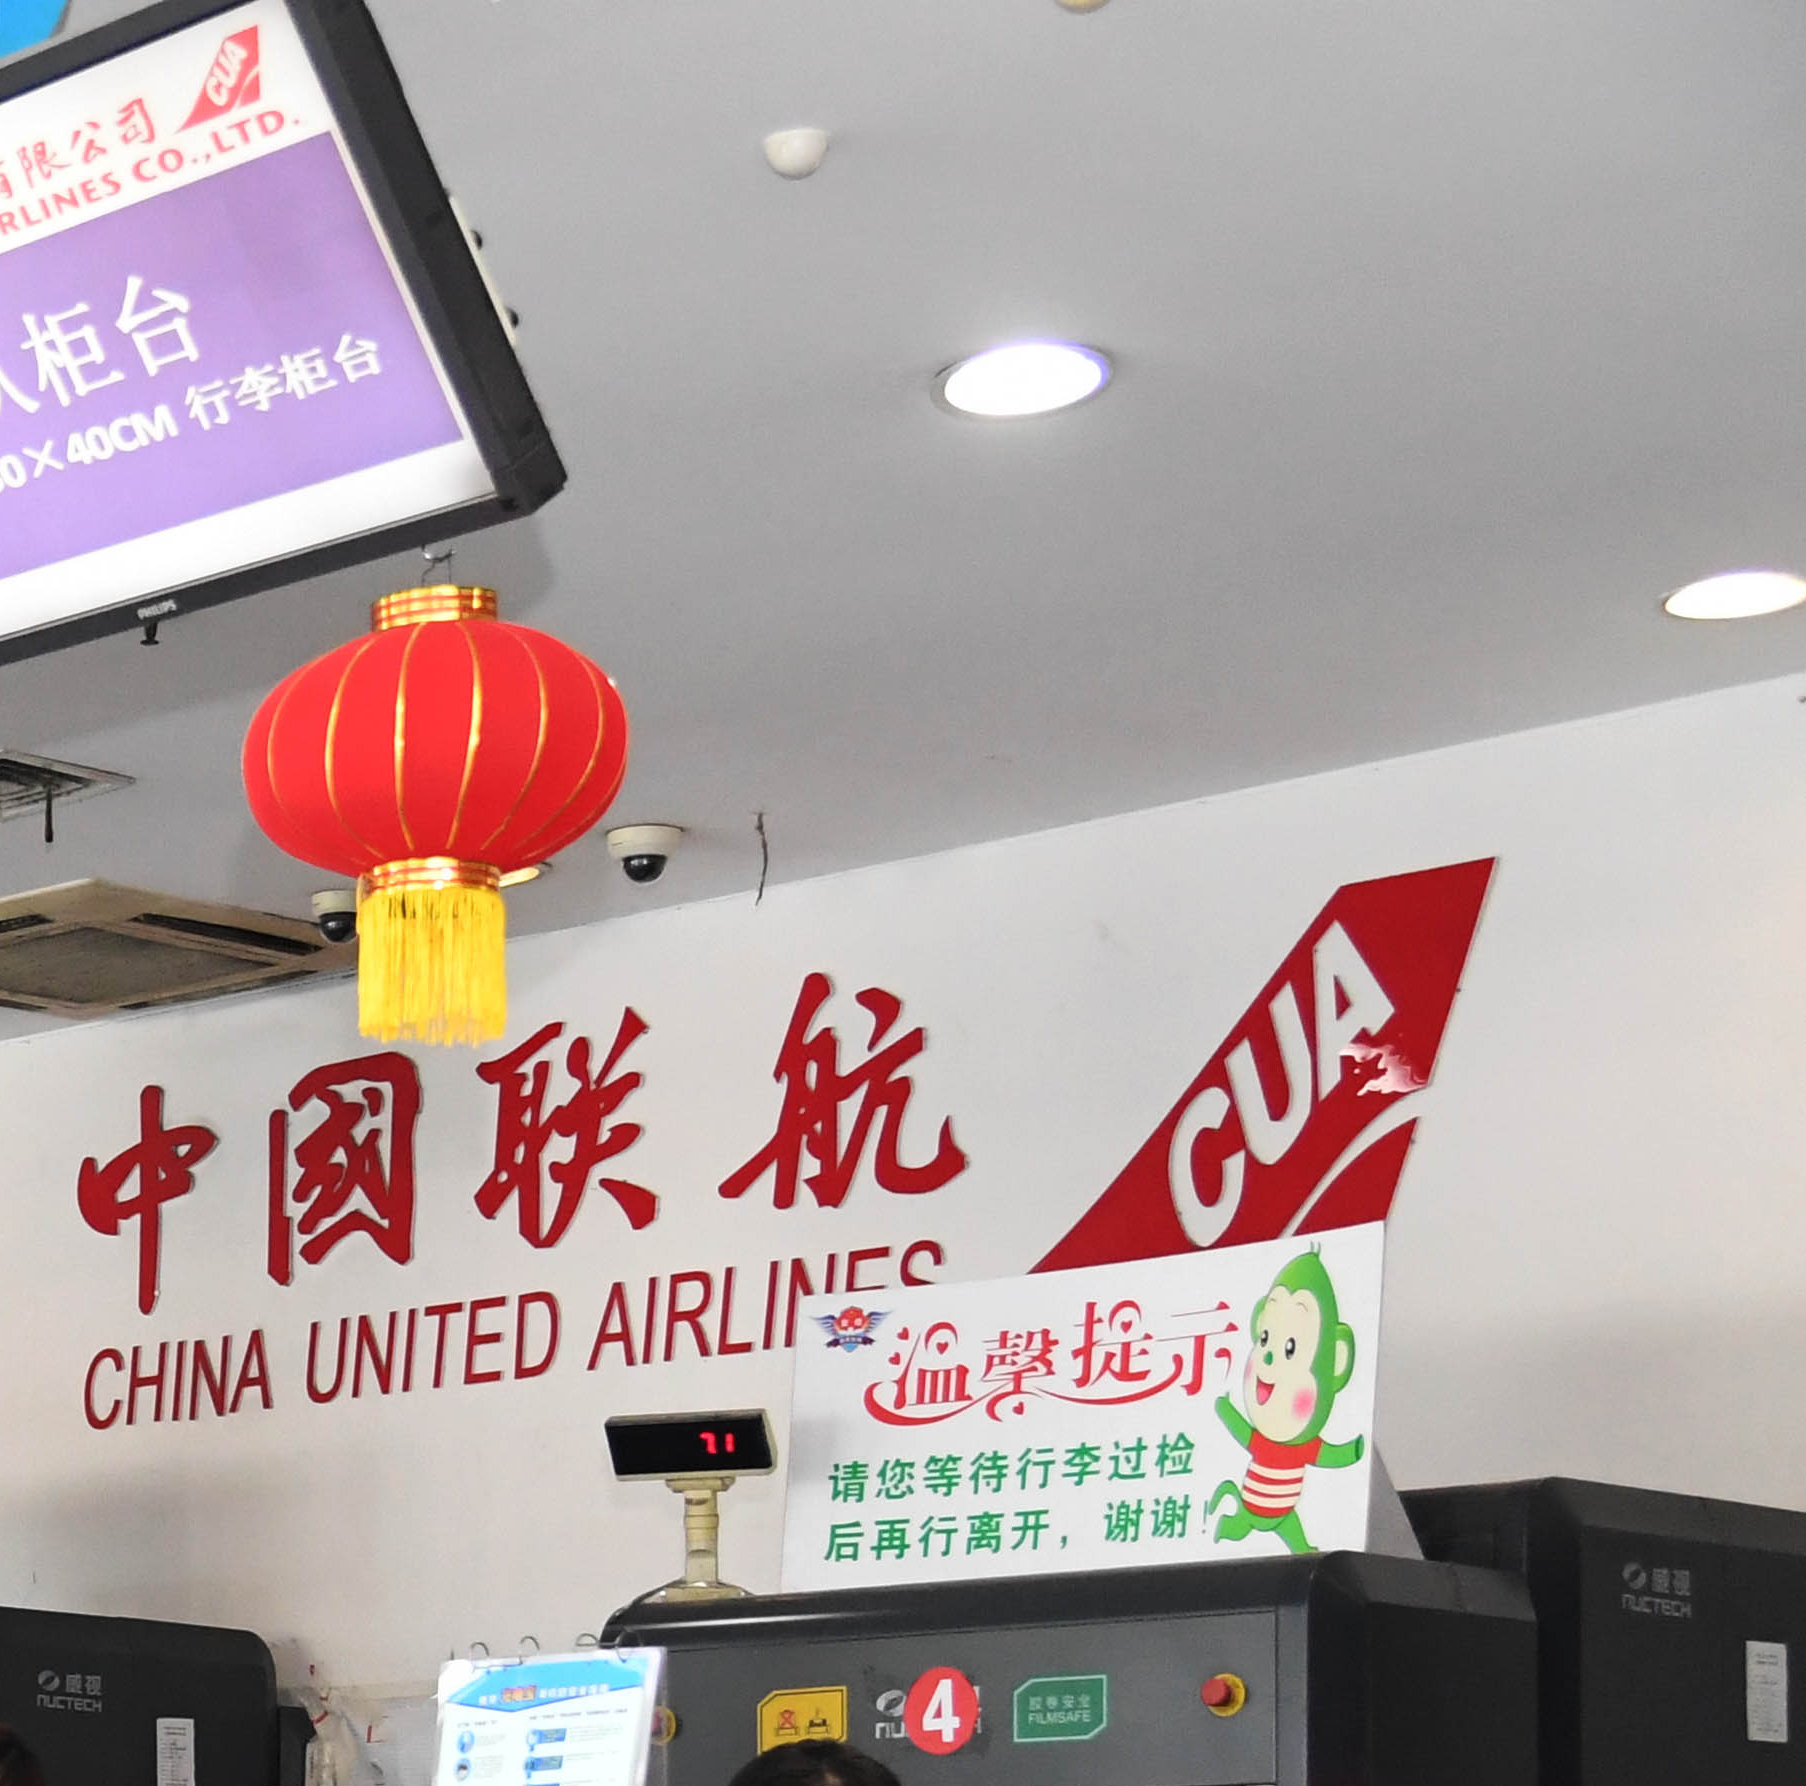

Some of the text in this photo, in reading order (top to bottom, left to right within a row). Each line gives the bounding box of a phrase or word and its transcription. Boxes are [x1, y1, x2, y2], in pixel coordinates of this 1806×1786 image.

[206, 40, 248, 107] CUA
[183, 333, 385, 432] 行李柜台
[1167, 919, 1394, 1247] CUA
[83, 1327, 274, 1430] CHINA
[304, 1291, 563, 1405] UNITED
[864, 1299, 1240, 1427] 温馨提示
[827, 1431, 1196, 1505] 请您等待行李过检
[37, 1694, 102, 1713] NUCTECH
[923, 1679, 960, 1742] 4
[1028, 1711, 1091, 1725] FILMSAFE
